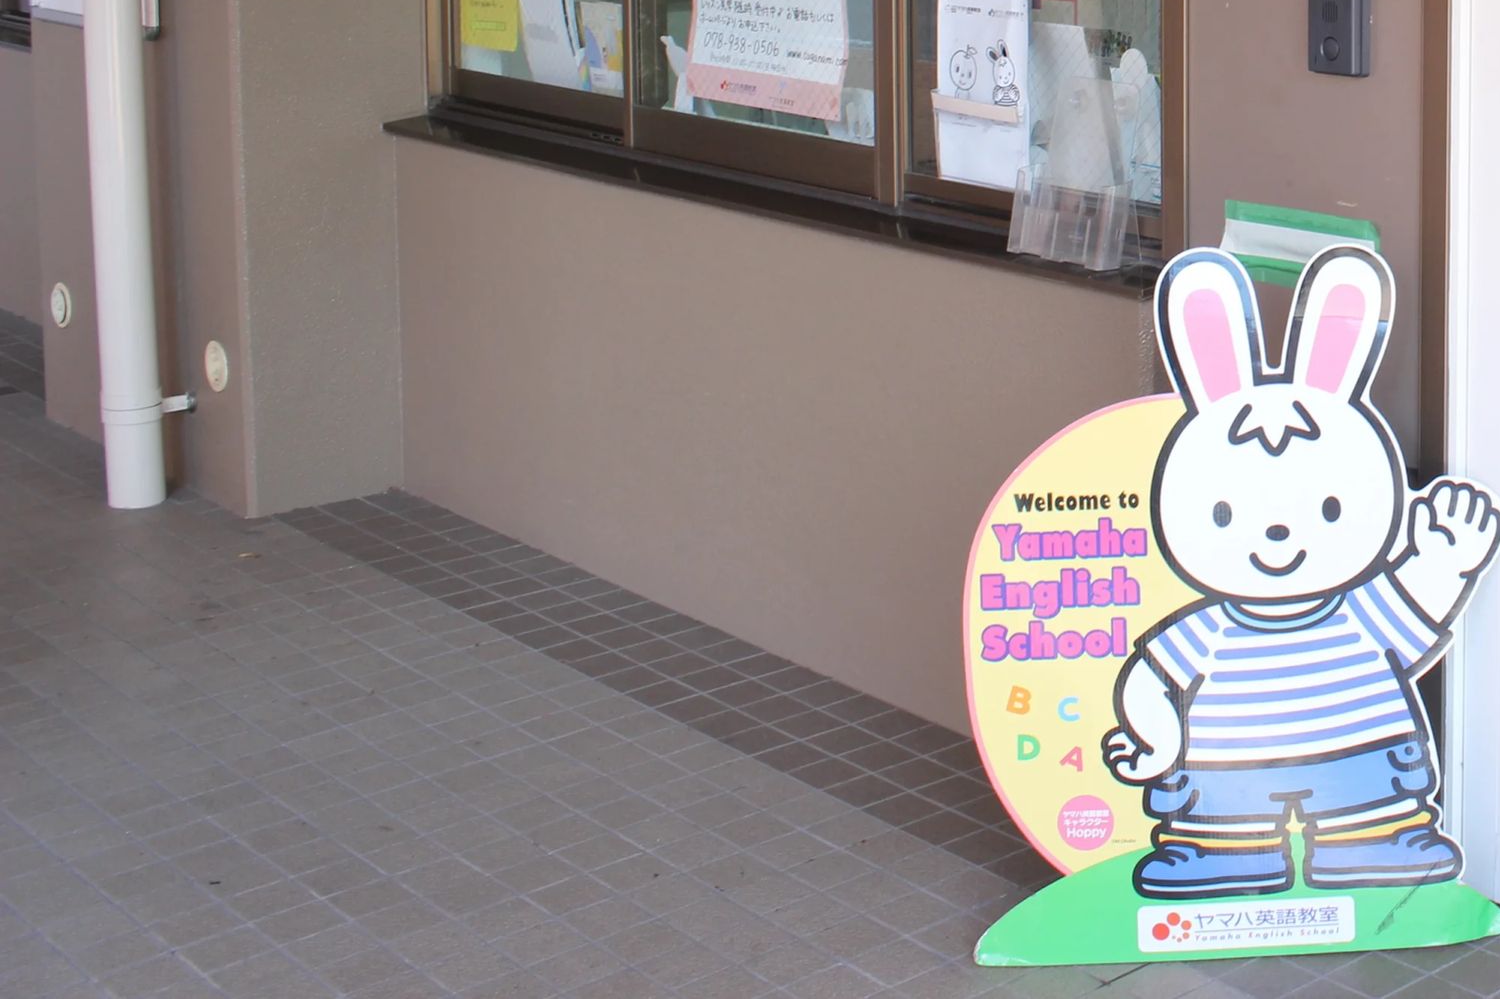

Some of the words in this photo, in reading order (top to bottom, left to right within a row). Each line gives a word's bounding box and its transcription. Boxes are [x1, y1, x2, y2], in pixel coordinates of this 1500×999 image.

[703, 31, 780, 57] 078-938-0506
[1013, 492, 1111, 512] Welcome
[1118, 491, 1140, 508] to
[991, 516, 1148, 561] Yamaha
[980, 566, 1141, 619] English
[980, 616, 1128, 662] School
[1006, 685, 1032, 715] B
[1057, 696, 1081, 722] C
[1017, 734, 1041, 761] D
[1059, 746, 1084, 772] A
[1066, 827, 1107, 839] Hoppy
[1194, 906, 1340, 929] ヤマハ英語教室
[1194, 932, 1242, 942] Yamaha
[1248, 929, 1293, 941] English
[1300, 926, 1341, 937] School
